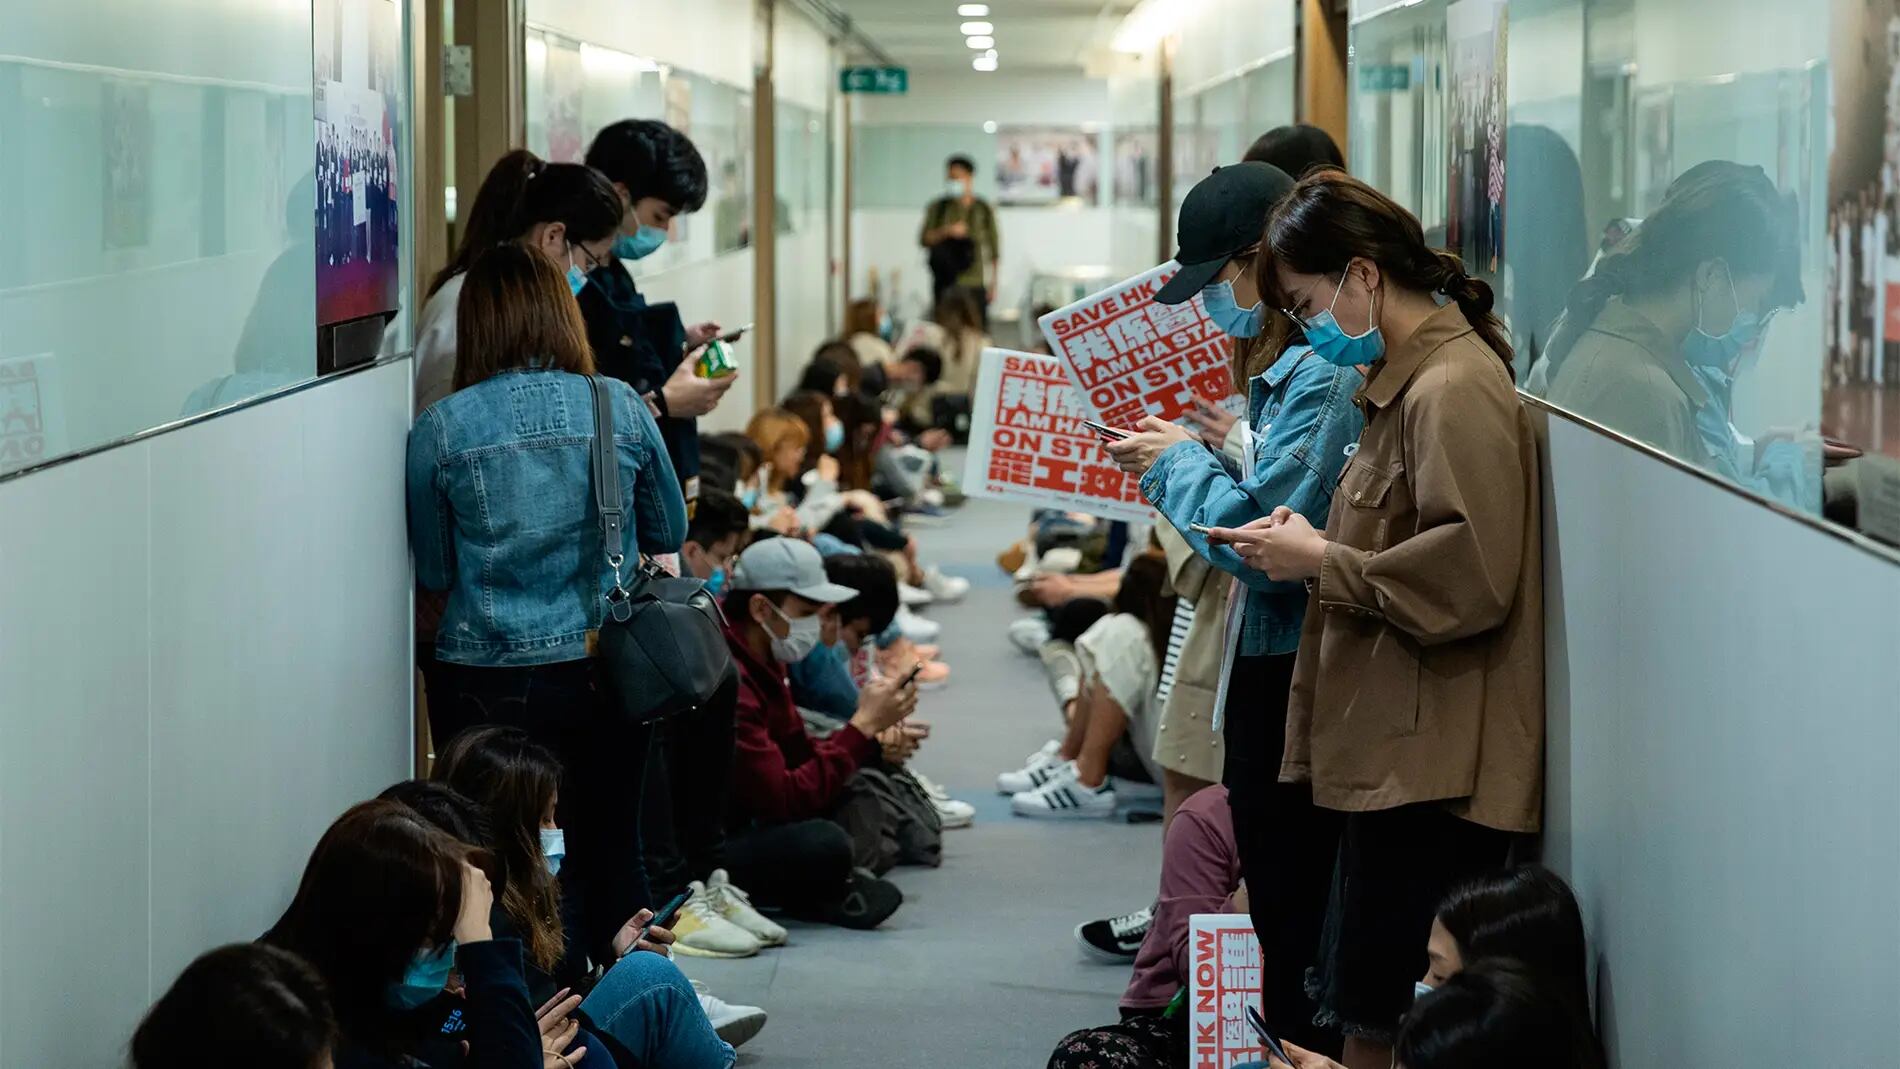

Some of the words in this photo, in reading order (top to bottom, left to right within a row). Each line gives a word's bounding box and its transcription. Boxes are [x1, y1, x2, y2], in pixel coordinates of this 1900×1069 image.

[1052, 297, 1119, 335] SAVE
[1120, 280, 1157, 307] HK
[1081, 369, 1093, 388] I
[1095, 354, 1134, 383] AM
[1132, 340, 1173, 366] HA
[1170, 319, 1223, 349] STA
[1090, 376, 1141, 409] ON
[1143, 337, 1232, 387] STRI
[992, 428, 1042, 453] ON
[999, 408, 1007, 424] I
[1011, 410, 1050, 431] AM
[1196, 929, 1216, 1013] NOW
[441, 1009, 462, 1034] 15:16
[1196, 1021, 1216, 1069] HK
